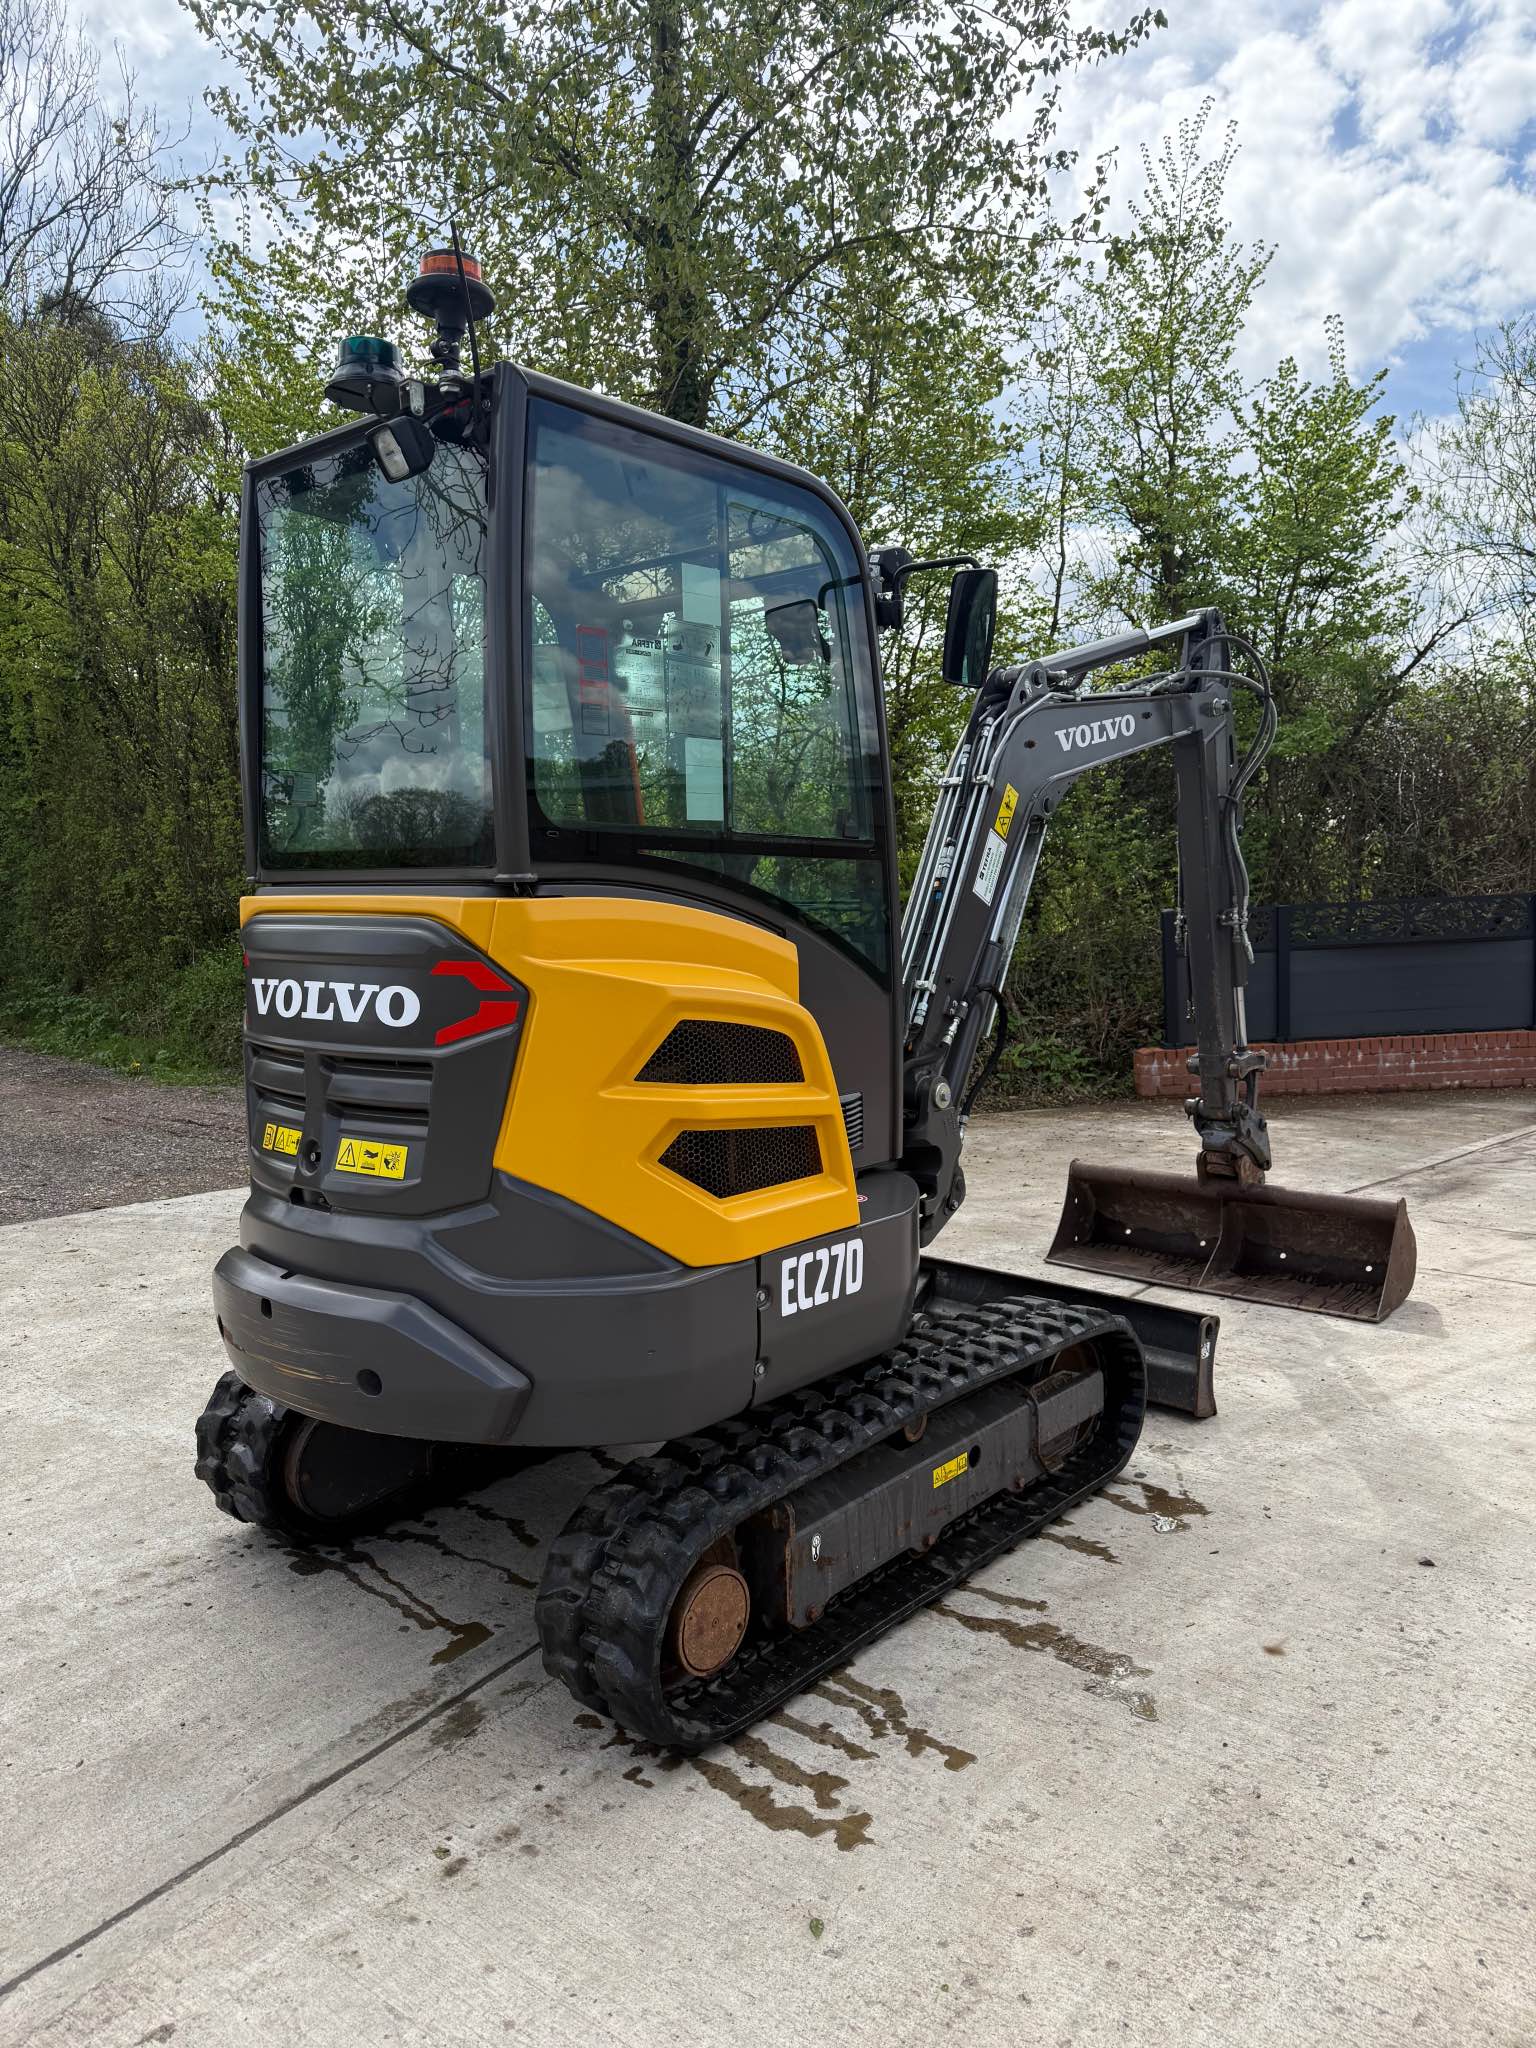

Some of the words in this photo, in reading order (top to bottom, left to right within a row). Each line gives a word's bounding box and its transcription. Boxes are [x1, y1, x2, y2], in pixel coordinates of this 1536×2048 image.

[1055, 714, 1136, 752] VOLVO
[251, 978, 421, 1027] VOLVO
[781, 1238, 864, 1317] EC27D
